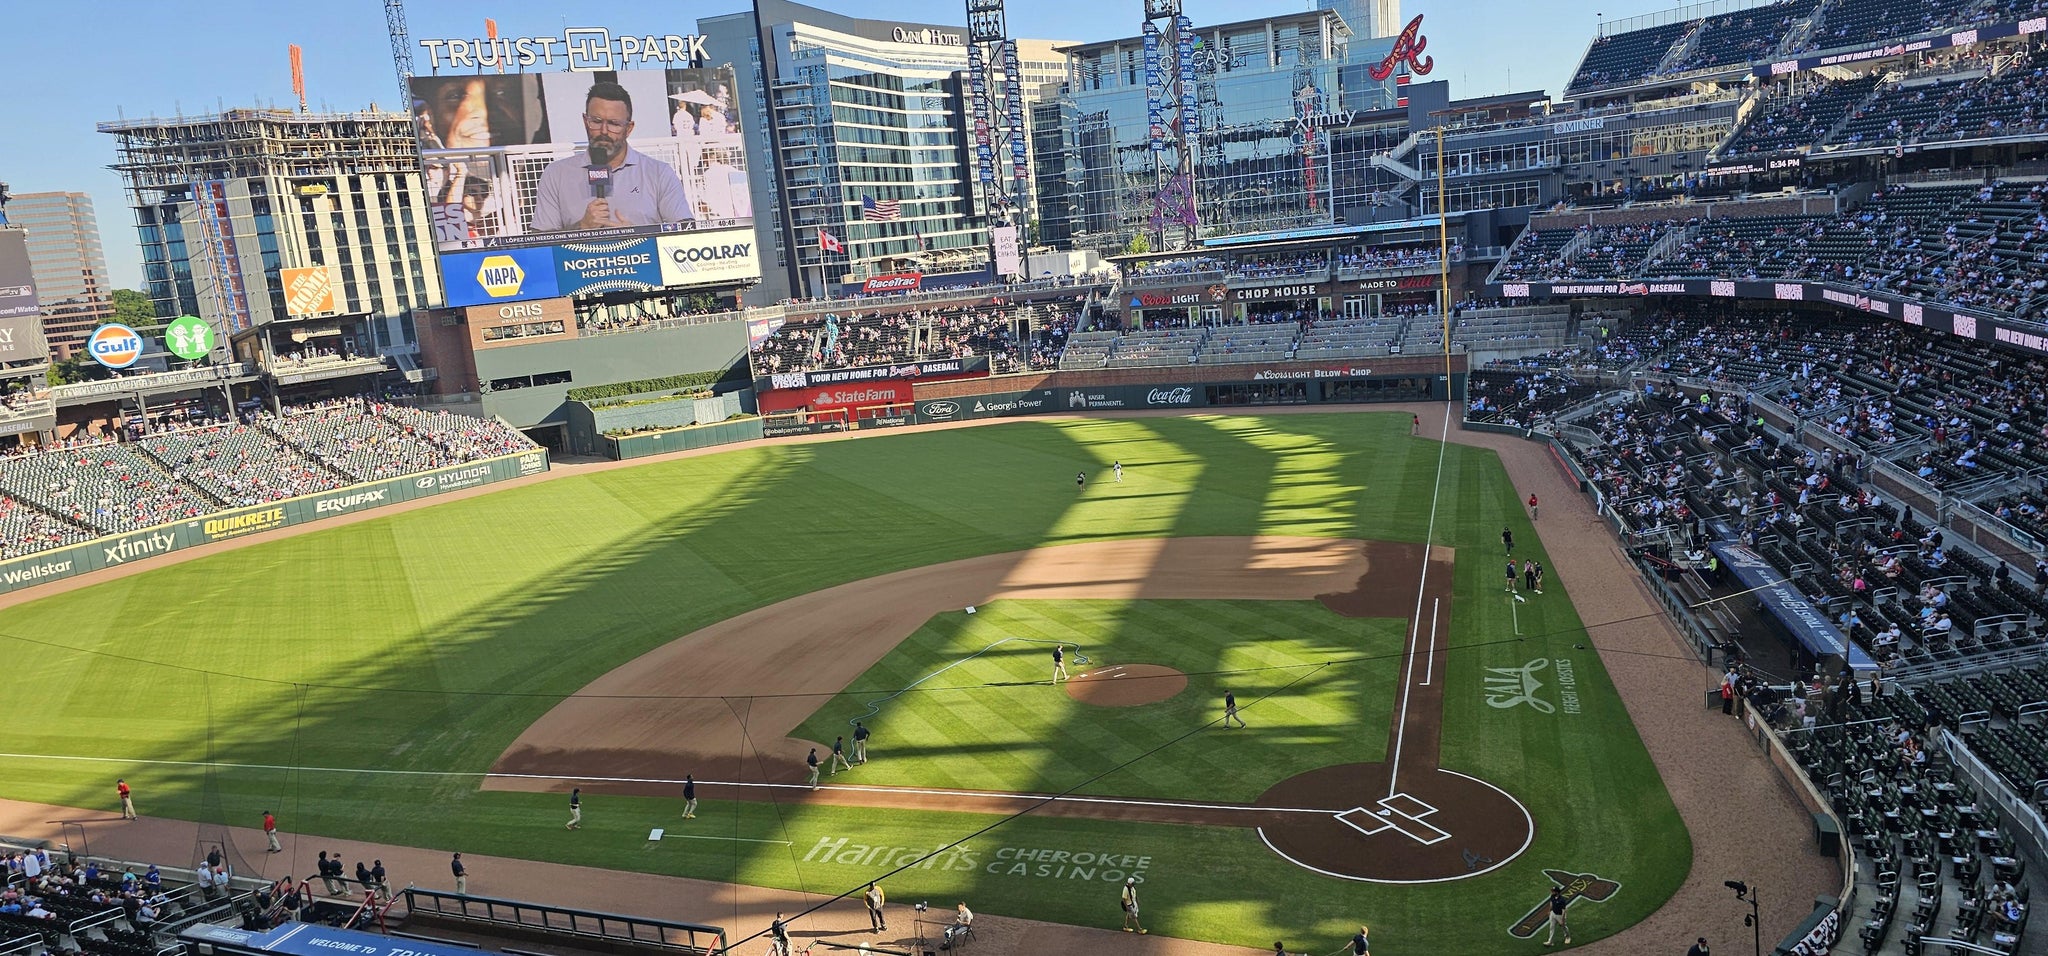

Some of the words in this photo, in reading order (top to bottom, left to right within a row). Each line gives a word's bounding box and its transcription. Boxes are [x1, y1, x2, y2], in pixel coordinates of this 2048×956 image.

[420, 37, 557, 68] TRUIST
[619, 34, 712, 63] PARK
[1820, 57, 1836, 65] YOUR
[1838, 55, 1852, 63] NEW
[1853, 52, 1872, 61] HOME
[1872, 50, 1884, 58] FOR
[1906, 41, 1932, 52] BASEBALL
[1295, 109, 1357, 132] xfinity
[1565, 119, 1602, 132] MILNER
[1896, 146, 1904, 158] 3
[1770, 160, 1786, 168] 6:34
[1788, 158, 1800, 167] PM
[673, 243, 752, 264] COOLRAY
[564, 253, 651, 272] NORTHSIDE
[290, 272, 308, 290] THE
[484, 266, 518, 286] NAPA
[582, 267, 637, 279] HOSPITAL
[289, 267, 329, 313] HOME
[868, 277, 915, 289] RaceTrac
[1360, 282, 1384, 290] MADE
[1386, 280, 1397, 288] TO
[1552, 286, 1568, 294] YOUR
[1568, 285, 1583, 294] NEW
[1584, 285, 1604, 294] HOME
[1604, 285, 1618, 293] FOR
[1650, 284, 1685, 293] BASEBALL
[308, 283, 332, 312] DEPOT
[1141, 293, 1172, 306] Coors
[1172, 294, 1200, 304] LIGHT
[1237, 288, 1268, 300] CHOP
[1274, 285, 1316, 298] HOUSE
[499, 303, 543, 320] ORIS
[94, 337, 137, 354] Gulf
[772, 373, 806, 382] BRAVES
[812, 373, 832, 383] YOUR
[832, 372, 850, 382] NEW
[850, 370, 872, 380] HOME
[873, 369, 888, 378] FOR
[923, 362, 960, 373] BASEBALL
[1263, 369, 1288, 380] Coors
[1288, 371, 1310, 379] LIGHT
[1314, 370, 1340, 378] BELOW
[1350, 368, 1371, 376] CHOP
[772, 380, 807, 388] VISION
[1147, 387, 1193, 404] Coca-Cola
[928, 403, 953, 415] Ford
[986, 402, 1017, 412] Georgia
[1018, 400, 1043, 408] Power
[520, 453, 540, 464] PAPA
[520, 462, 542, 472] JOHNS
[439, 465, 490, 484] HYUNDAI
[316, 490, 385, 513] EQUIFAX
[204, 508, 284, 534] QUIKRETE
[104, 532, 176, 564] xfinity
[4, 559, 72, 584] Wellstar
[1555, 658, 1576, 685] LOGISTICS
[996, 848, 1152, 870] CHEROKEE
[986, 862, 1146, 884] CASINOS
[308, 938, 362, 952] WELCOME
[362, 946, 377, 954] TO
